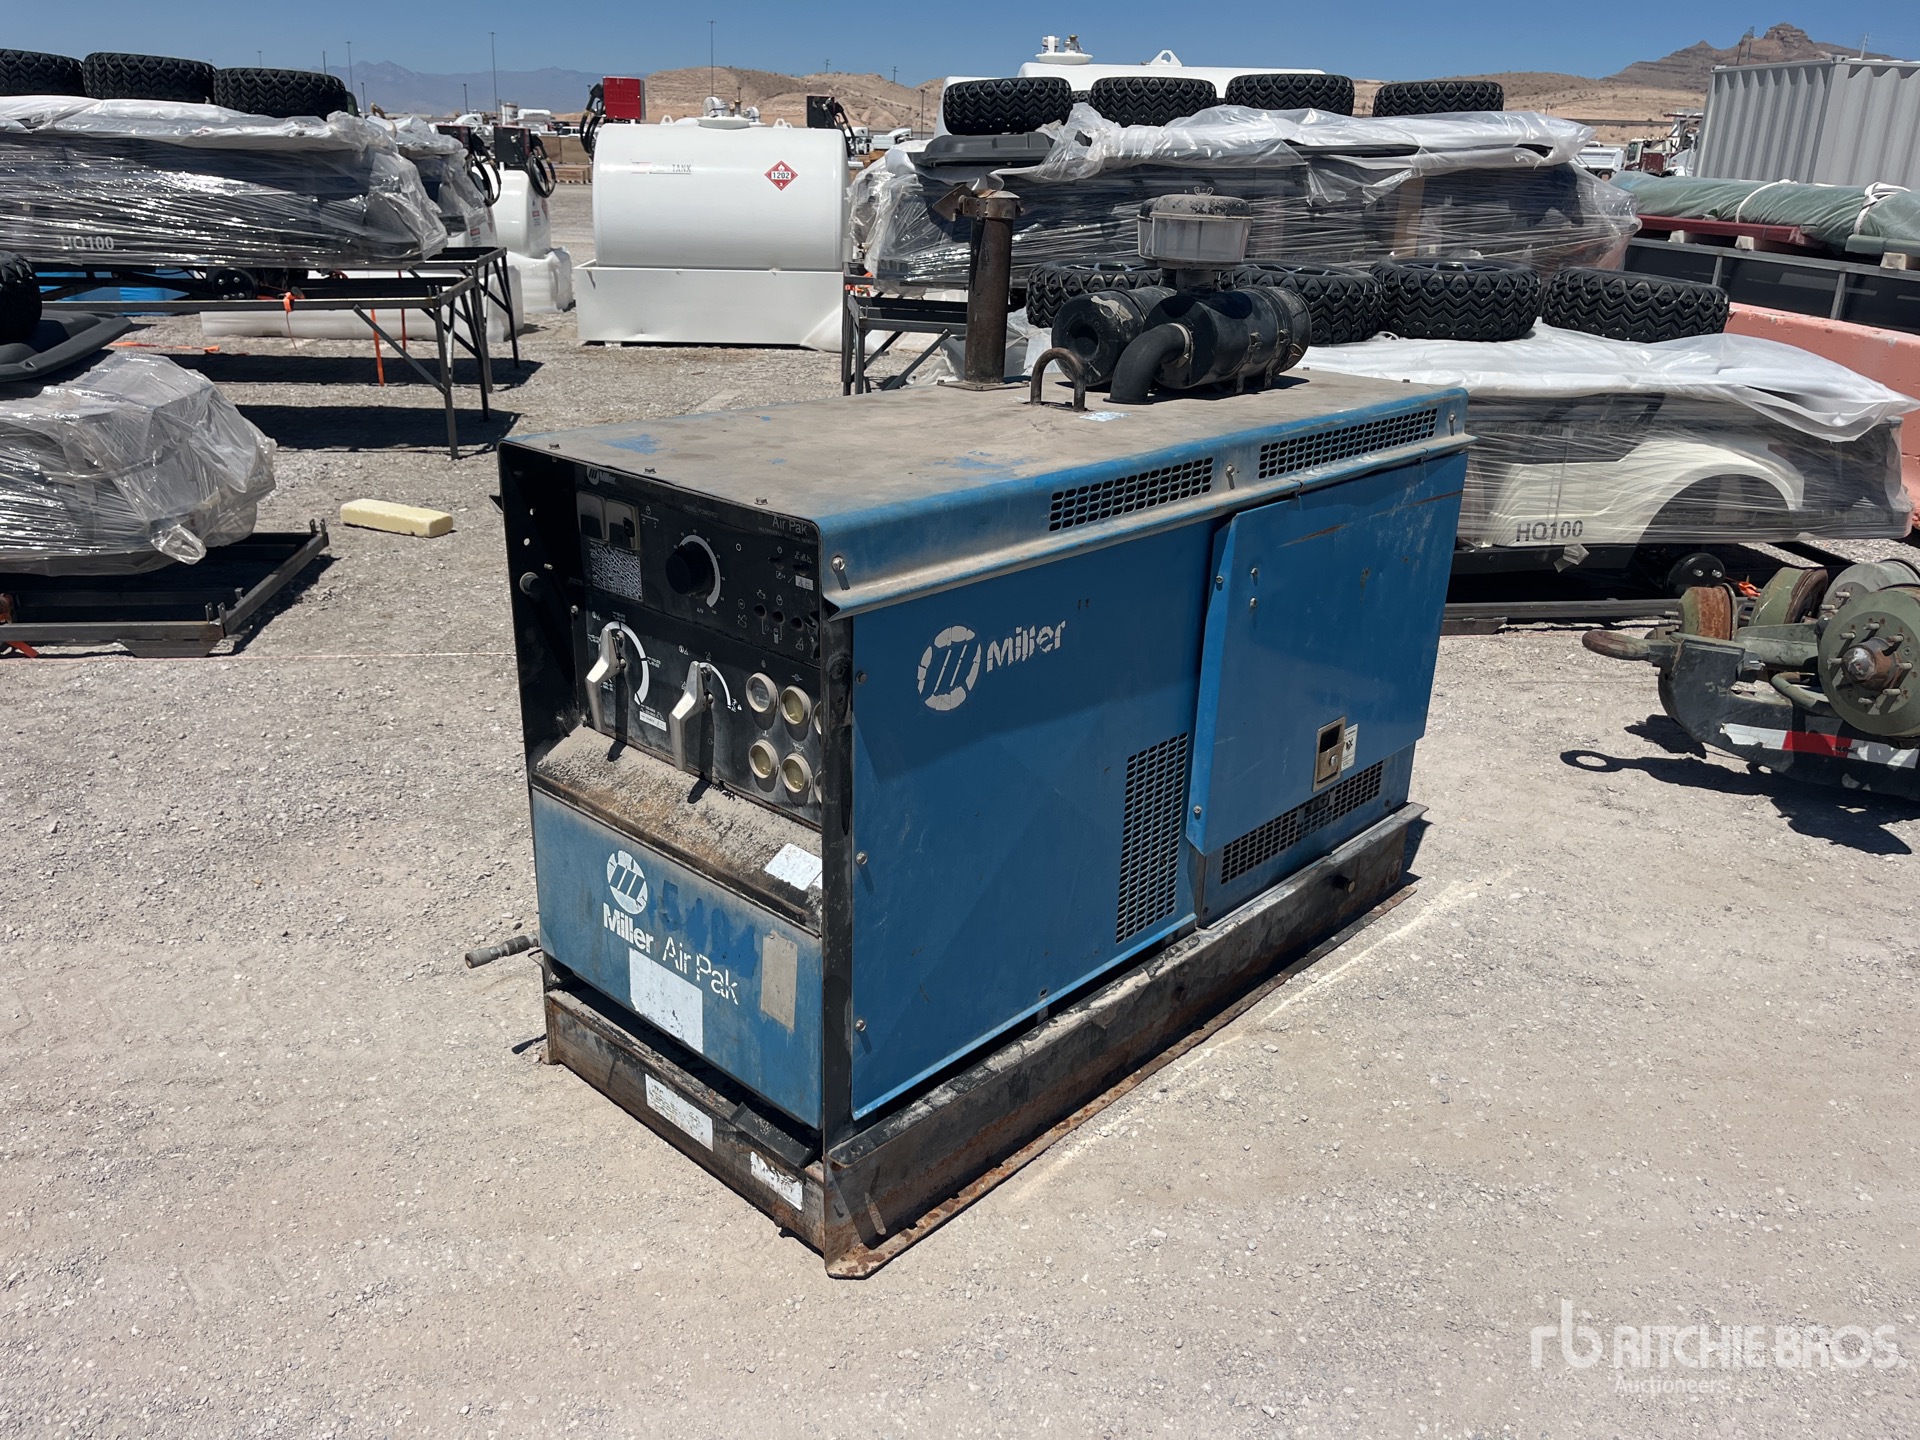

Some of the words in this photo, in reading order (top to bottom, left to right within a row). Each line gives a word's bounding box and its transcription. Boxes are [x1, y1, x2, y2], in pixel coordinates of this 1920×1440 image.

[60, 235, 115, 250] HQ100
[772, 515, 786, 531] Air
[789, 519, 808, 535] Pak
[1516, 520, 1583, 542] HQ100
[986, 620, 1066, 673] Miller
[602, 902, 654, 954] Miller
[662, 936, 691, 974] Air
[696, 953, 739, 1006] Pak
